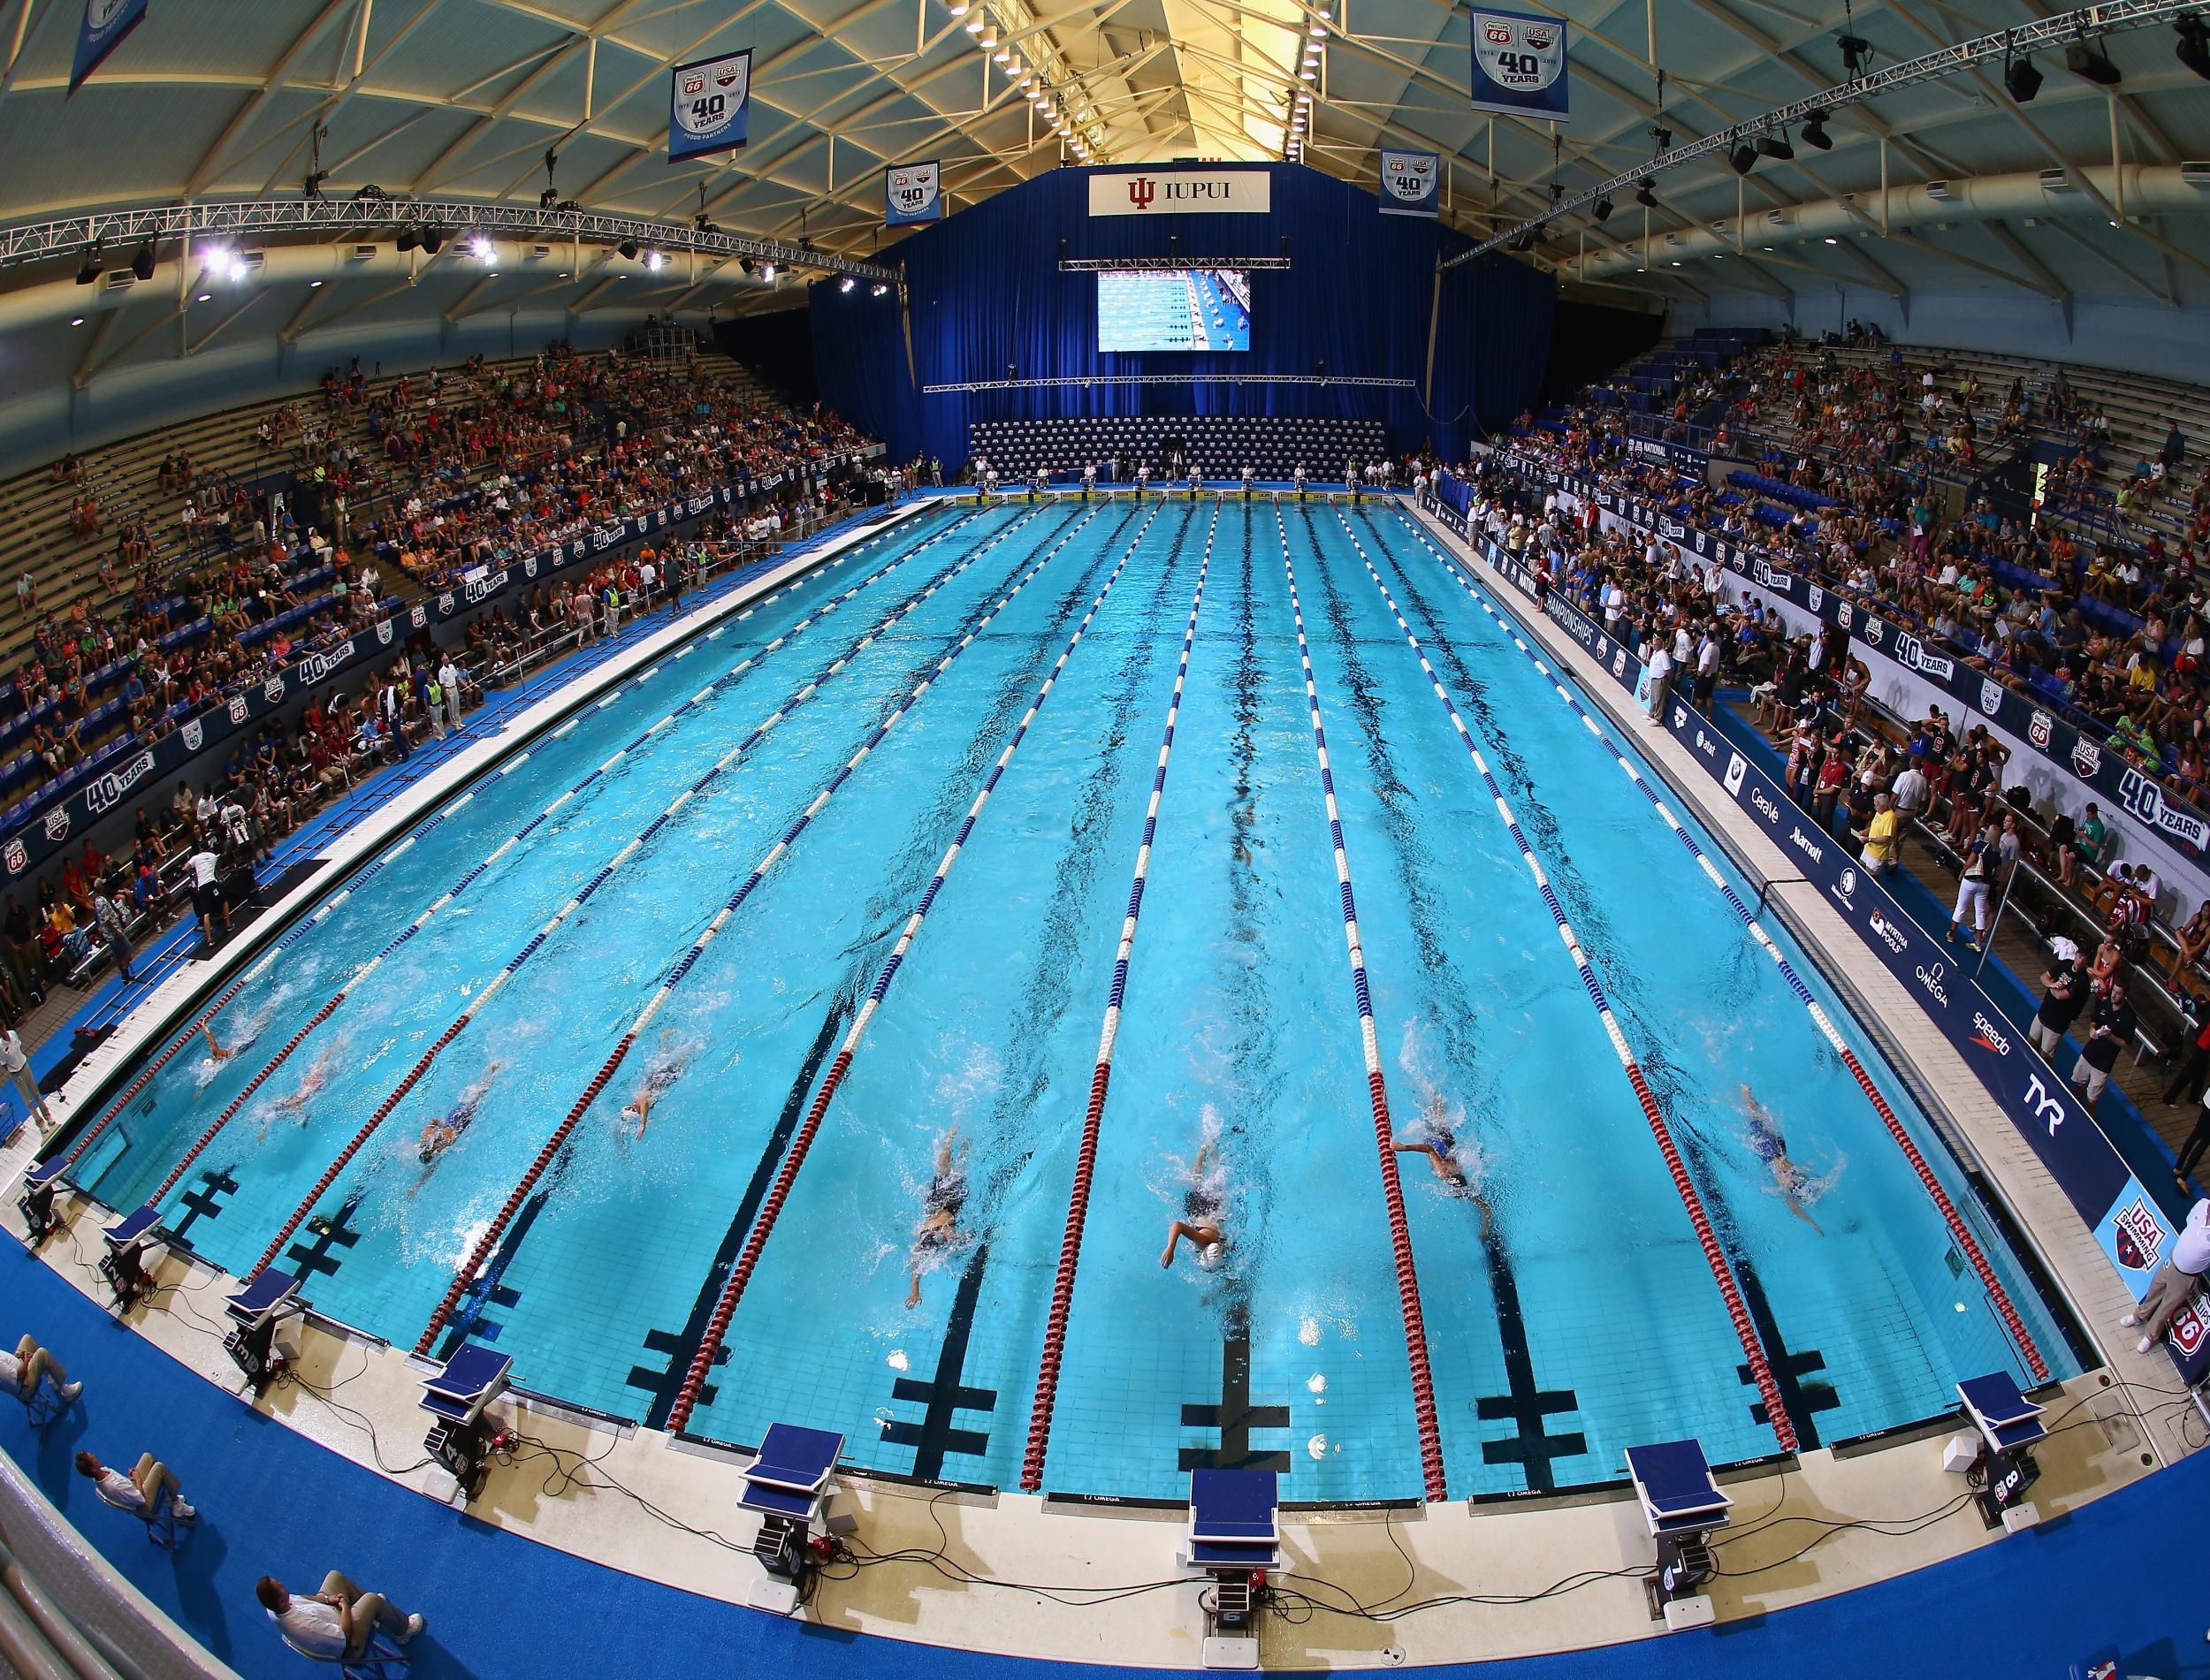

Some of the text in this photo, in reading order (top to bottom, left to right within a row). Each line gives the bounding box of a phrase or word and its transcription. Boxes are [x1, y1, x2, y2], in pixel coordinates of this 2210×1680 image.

[1489, 30, 1506, 41] 66
[1528, 28, 1547, 38] USA
[719, 66, 735, 75] USA
[1497, 51, 1538, 75] 40
[686, 81, 701, 92] 66
[1501, 74, 1539, 83] YEARS
[691, 94, 725, 118] 40
[693, 112, 725, 128] YEARS
[702, 123, 732, 140] PARTNERS
[1165, 182, 1231, 200] IUPUI
[1396, 177, 1421, 190] 40
[901, 187, 924, 202] 40
[903, 200, 924, 209] YEARS
[689, 498, 701, 515] 40
[1659, 515, 1672, 538] 40
[593, 529, 609, 551] 40
[1753, 559, 1788, 588] 40 YEARS
[466, 574, 505, 604] 40 YEARS
[415, 613, 423, 625] 66
[1840, 612, 1848, 624] 66
[1894, 631, 1948, 673] 40 YEARS
[300, 645, 350, 686] 40 YEARS
[267, 677, 280, 689] USA
[1984, 696, 1994, 708] 40
[233, 704, 244, 719] 66
[189, 734, 199, 746] 40
[2031, 726, 2046, 741] 66
[2079, 742, 2095, 759] USA
[87, 757, 149, 814] 40 YEARS
[1751, 787, 1779, 824] CeraVe
[2119, 767, 2201, 840] 40 YEARS
[48, 811, 64, 826] USA
[1789, 825, 1823, 864] Marriott
[11, 849, 23, 869] 66
[1881, 930, 1900, 954] POOLS
[1885, 921, 1908, 949] MYRTHA
[1916, 965, 1947, 1008] OMEGA
[1972, 1011, 2010, 1056] speedo
[2023, 1073, 2065, 1137] TYR
[2131, 1207, 2158, 1246] USA
[2120, 1214, 2154, 1262] SWIMMING
[108, 1266, 119, 1281] 2
[237, 1343, 249, 1361] 3
[446, 1442, 458, 1461] 4
[2005, 1470, 2019, 1488] 8
[782, 1541, 793, 1562] 5
[1223, 1611, 1241, 1622] 6
